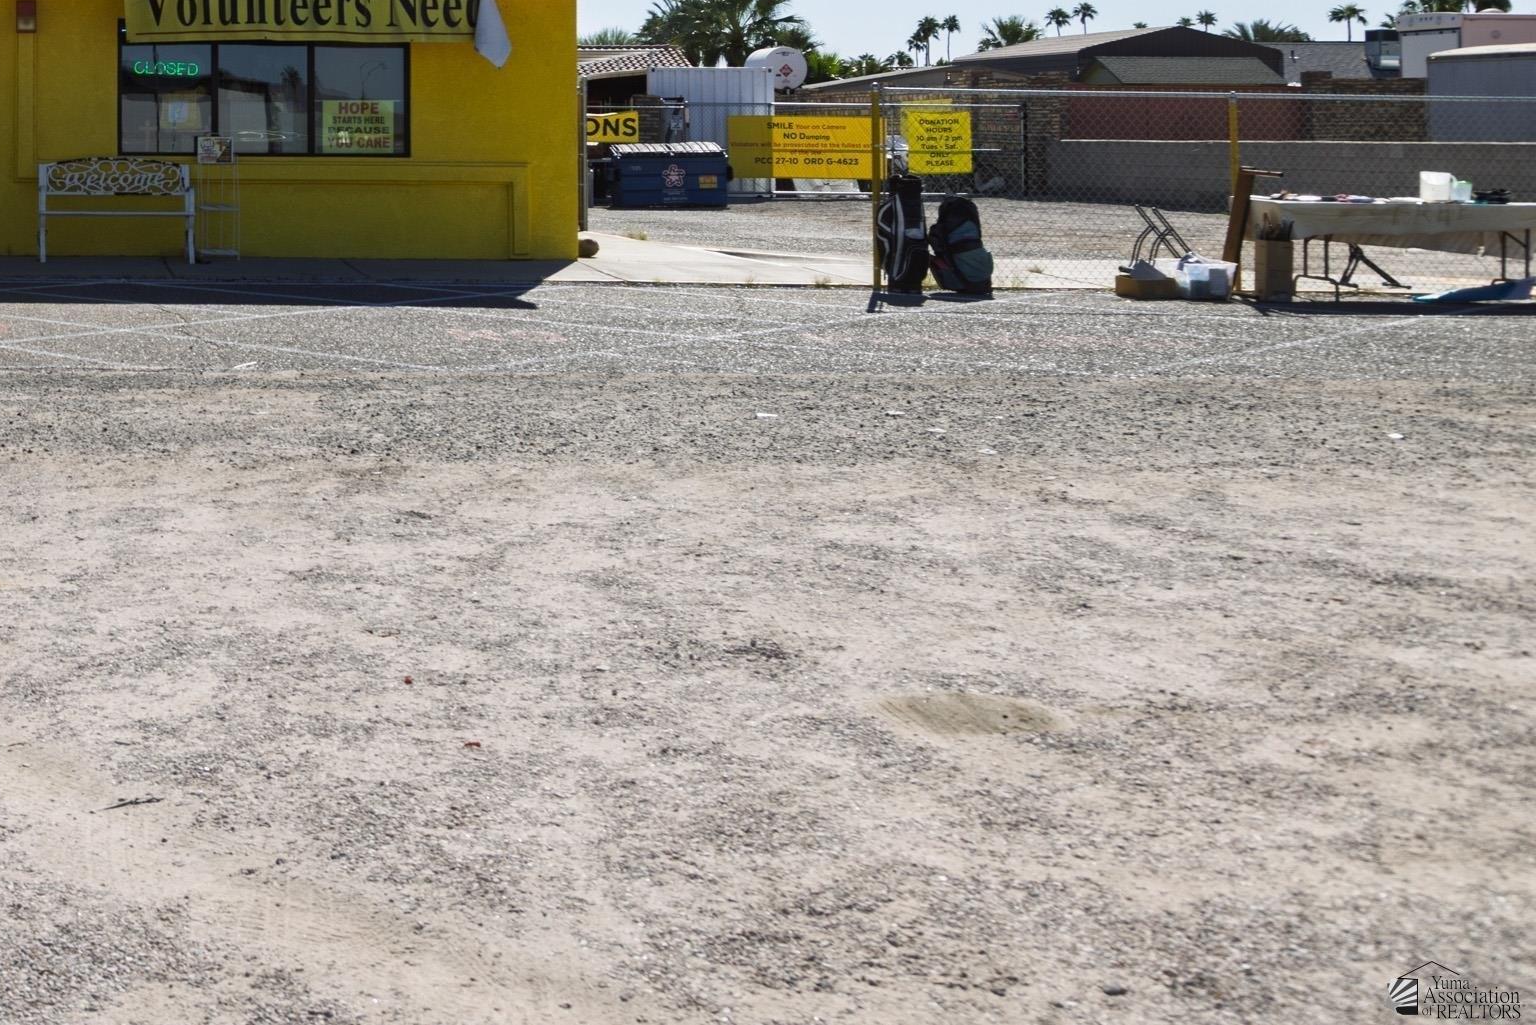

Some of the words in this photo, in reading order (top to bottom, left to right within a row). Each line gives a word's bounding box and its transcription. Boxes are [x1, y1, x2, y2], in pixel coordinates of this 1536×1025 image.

[134, 61, 199, 76] CLOSED
[338, 102, 380, 115] HOPE
[332, 116, 363, 125] STARTS
[767, 122, 794, 130] SMILE
[784, 132, 798, 140] NO
[754, 157, 773, 165] PCC
[775, 157, 799, 165] 27-10
[804, 157, 824, 165] ORD
[826, 157, 859, 165] G-4623
